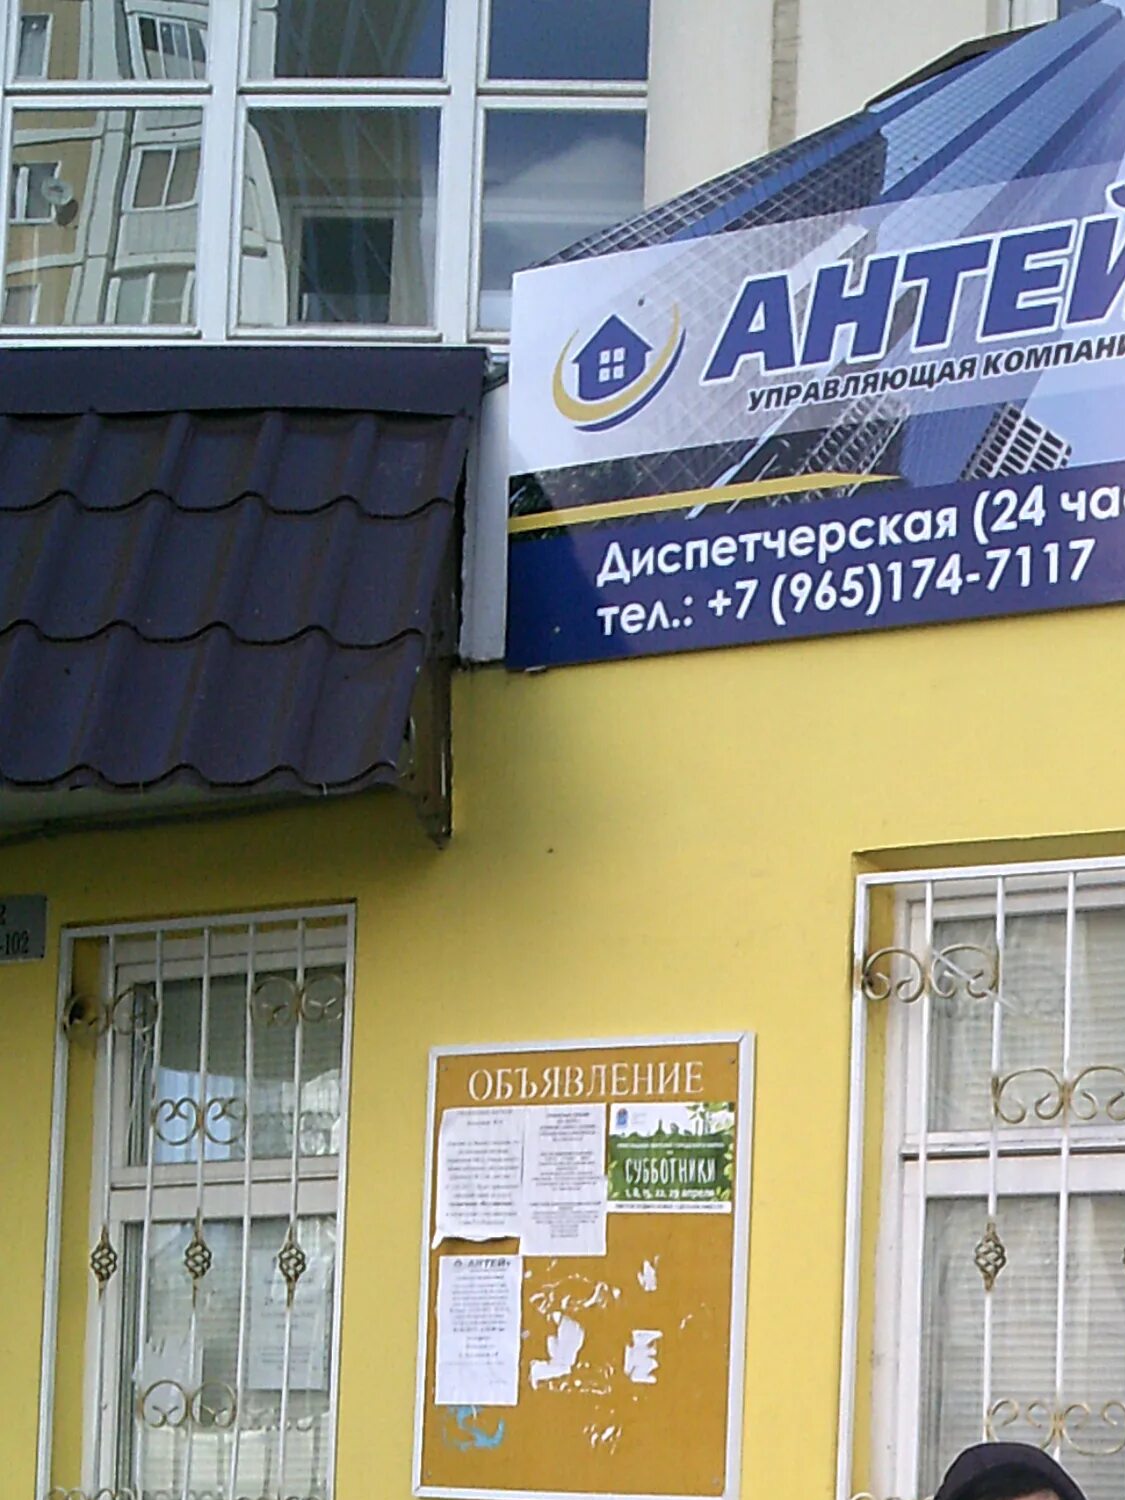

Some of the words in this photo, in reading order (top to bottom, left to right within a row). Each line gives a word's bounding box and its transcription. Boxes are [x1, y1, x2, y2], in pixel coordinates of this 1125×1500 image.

[747, 356, 978, 412] УПРАВЛЯЮЩАЯ
[596, 508, 957, 587] Диспетчерская
[973, 482, 1046, 545] (24
[596, 591, 694, 637] тел.:
[707, 579, 757, 624] +7
[770, 539, 1096, 628] (965)174-7117
[467, 1060, 705, 1102] ОБЪЯВЛЕНИЕ
[625, 1158, 716, 1184] СУББОТНИКИ
